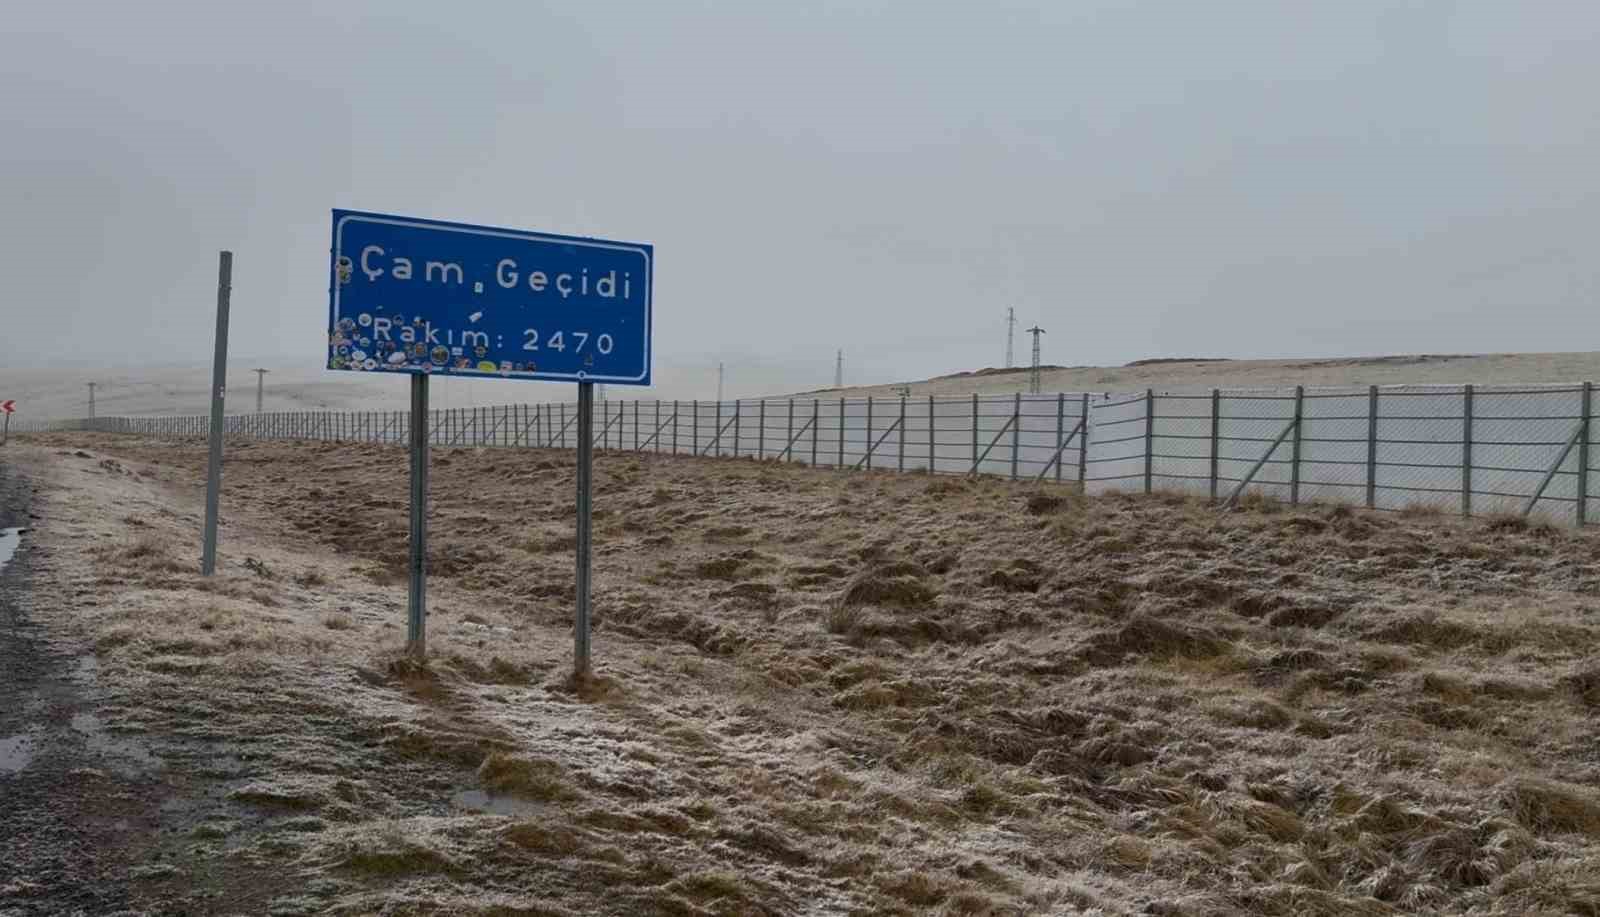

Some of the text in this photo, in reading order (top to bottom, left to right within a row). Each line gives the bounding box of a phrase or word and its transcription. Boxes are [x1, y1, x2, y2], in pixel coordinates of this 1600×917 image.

[360, 245, 631, 299] Çam Geçidi
[373, 317, 614, 355] Rakım: 2470
